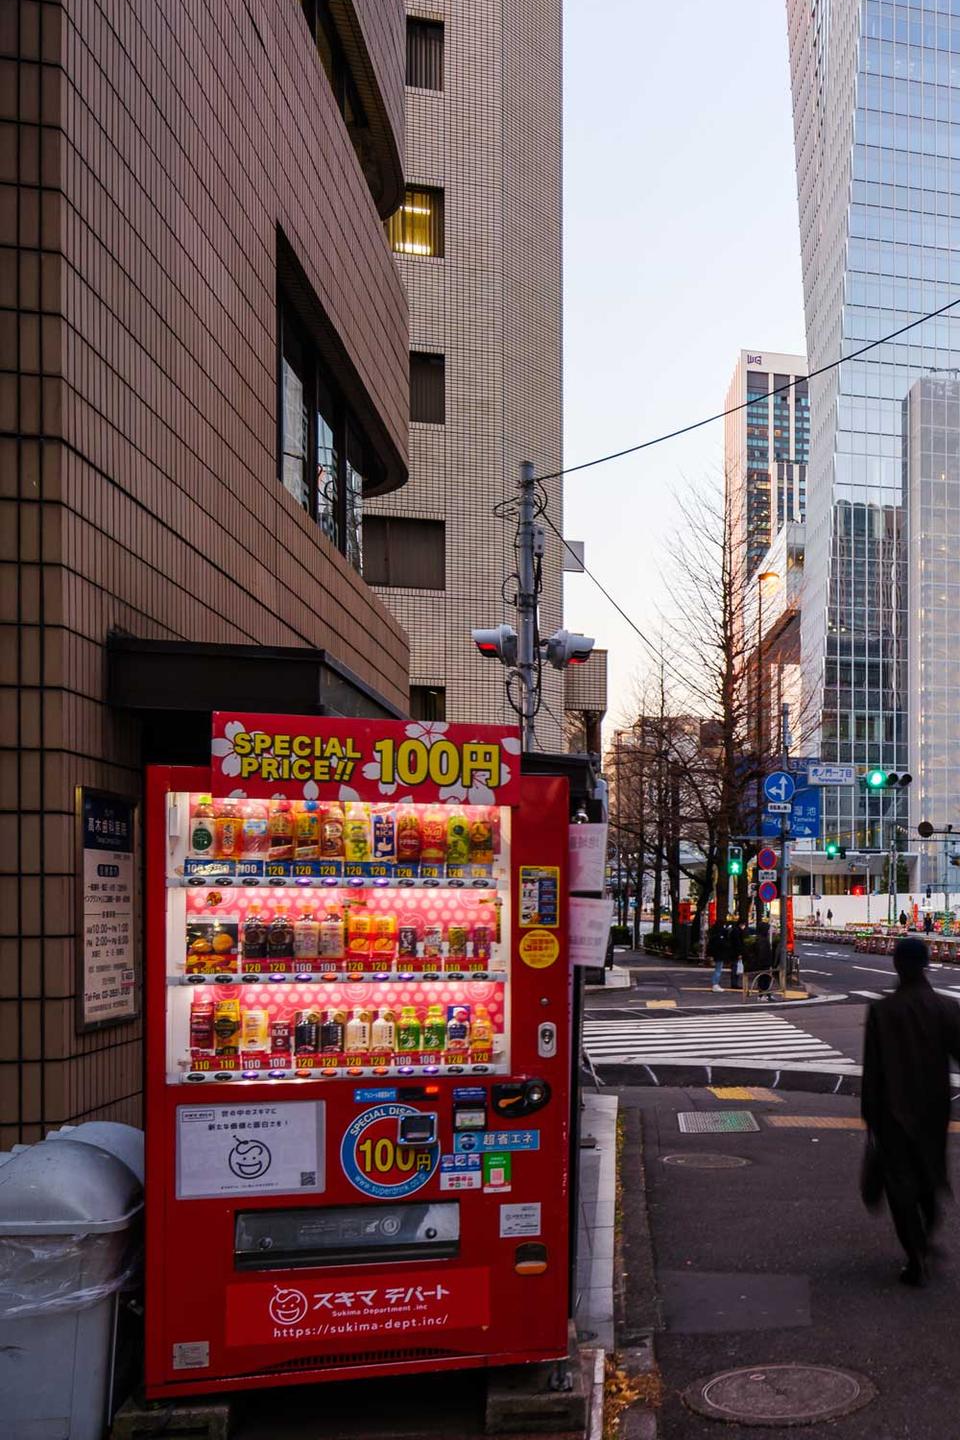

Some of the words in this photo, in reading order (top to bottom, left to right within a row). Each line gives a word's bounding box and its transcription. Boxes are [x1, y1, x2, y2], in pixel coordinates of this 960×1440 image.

[234, 732, 361, 759] SPECIAL
[375, 738, 501, 788] 100円
[240, 757, 354, 782] PRICE!!
[268, 866, 284, 875] 120
[295, 866, 311, 875] 120
[320, 866, 335, 875] 120
[346, 867, 361, 875] 120
[370, 866, 386, 875] 120
[397, 868, 412, 877] 120
[422, 868, 437, 877] 120
[448, 868, 463, 877] 120
[245, 963, 261, 972] 120
[269, 963, 285, 972] 120
[296, 963, 311, 972] 100
[320, 963, 336, 972] 100
[348, 962, 363, 971] 120
[194, 1060, 209, 1070] 110
[220, 1059, 234, 1069] 110
[244, 1059, 260, 1069] 100
[269, 1059, 285, 1068] 100
[297, 1058, 313, 1068] 120
[322, 1058, 337, 1068] 120
[346, 1057, 361, 1066] 120
[370, 1057, 385, 1066] 120
[396, 1056, 411, 1065] 100
[419, 1055, 435, 1064] 100
[448, 1055, 462, 1064] 120
[474, 1053, 488, 1062] 120
[350, 1108, 387, 1136] SPECIAL
[483, 1133, 533, 1146] 超省エネ
[360, 1138, 431, 1172] 100円
[313, 1291, 378, 1310] スキマ
[385, 1284, 450, 1304] デパート
[332, 1309, 361, 1317] Sukima
[363, 1304, 411, 1315] Department
[273, 1314, 448, 1338] https://sukima-dept.inc/
